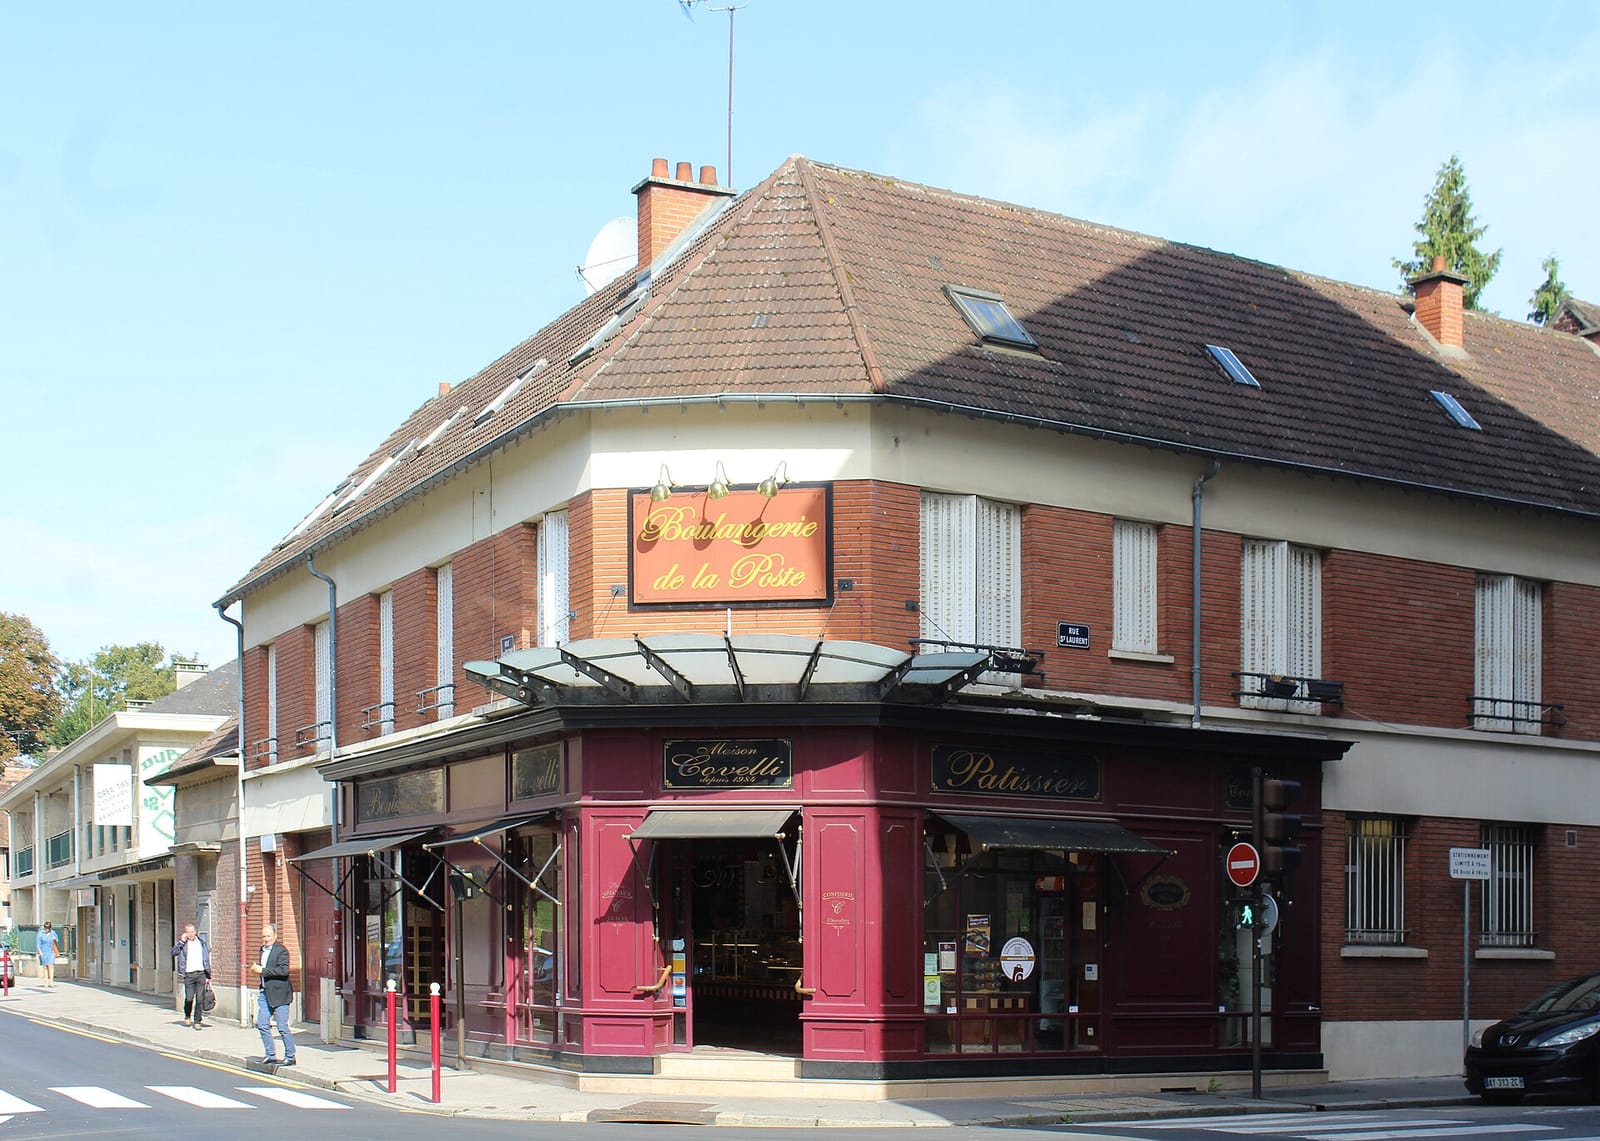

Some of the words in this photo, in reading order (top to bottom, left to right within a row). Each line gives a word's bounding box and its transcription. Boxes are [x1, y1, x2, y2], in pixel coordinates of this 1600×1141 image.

[641, 506, 820, 547] Boulangerie
[652, 563, 685, 591] de
[691, 562, 721, 590] la
[728, 553, 807, 589] Poste
[1068, 627, 1080, 635] RUE
[1066, 636, 1088, 645] LAURENT
[696, 742, 758, 756] Maison
[671, 753, 785, 777] Covelli
[699, 776, 730, 785] depuis
